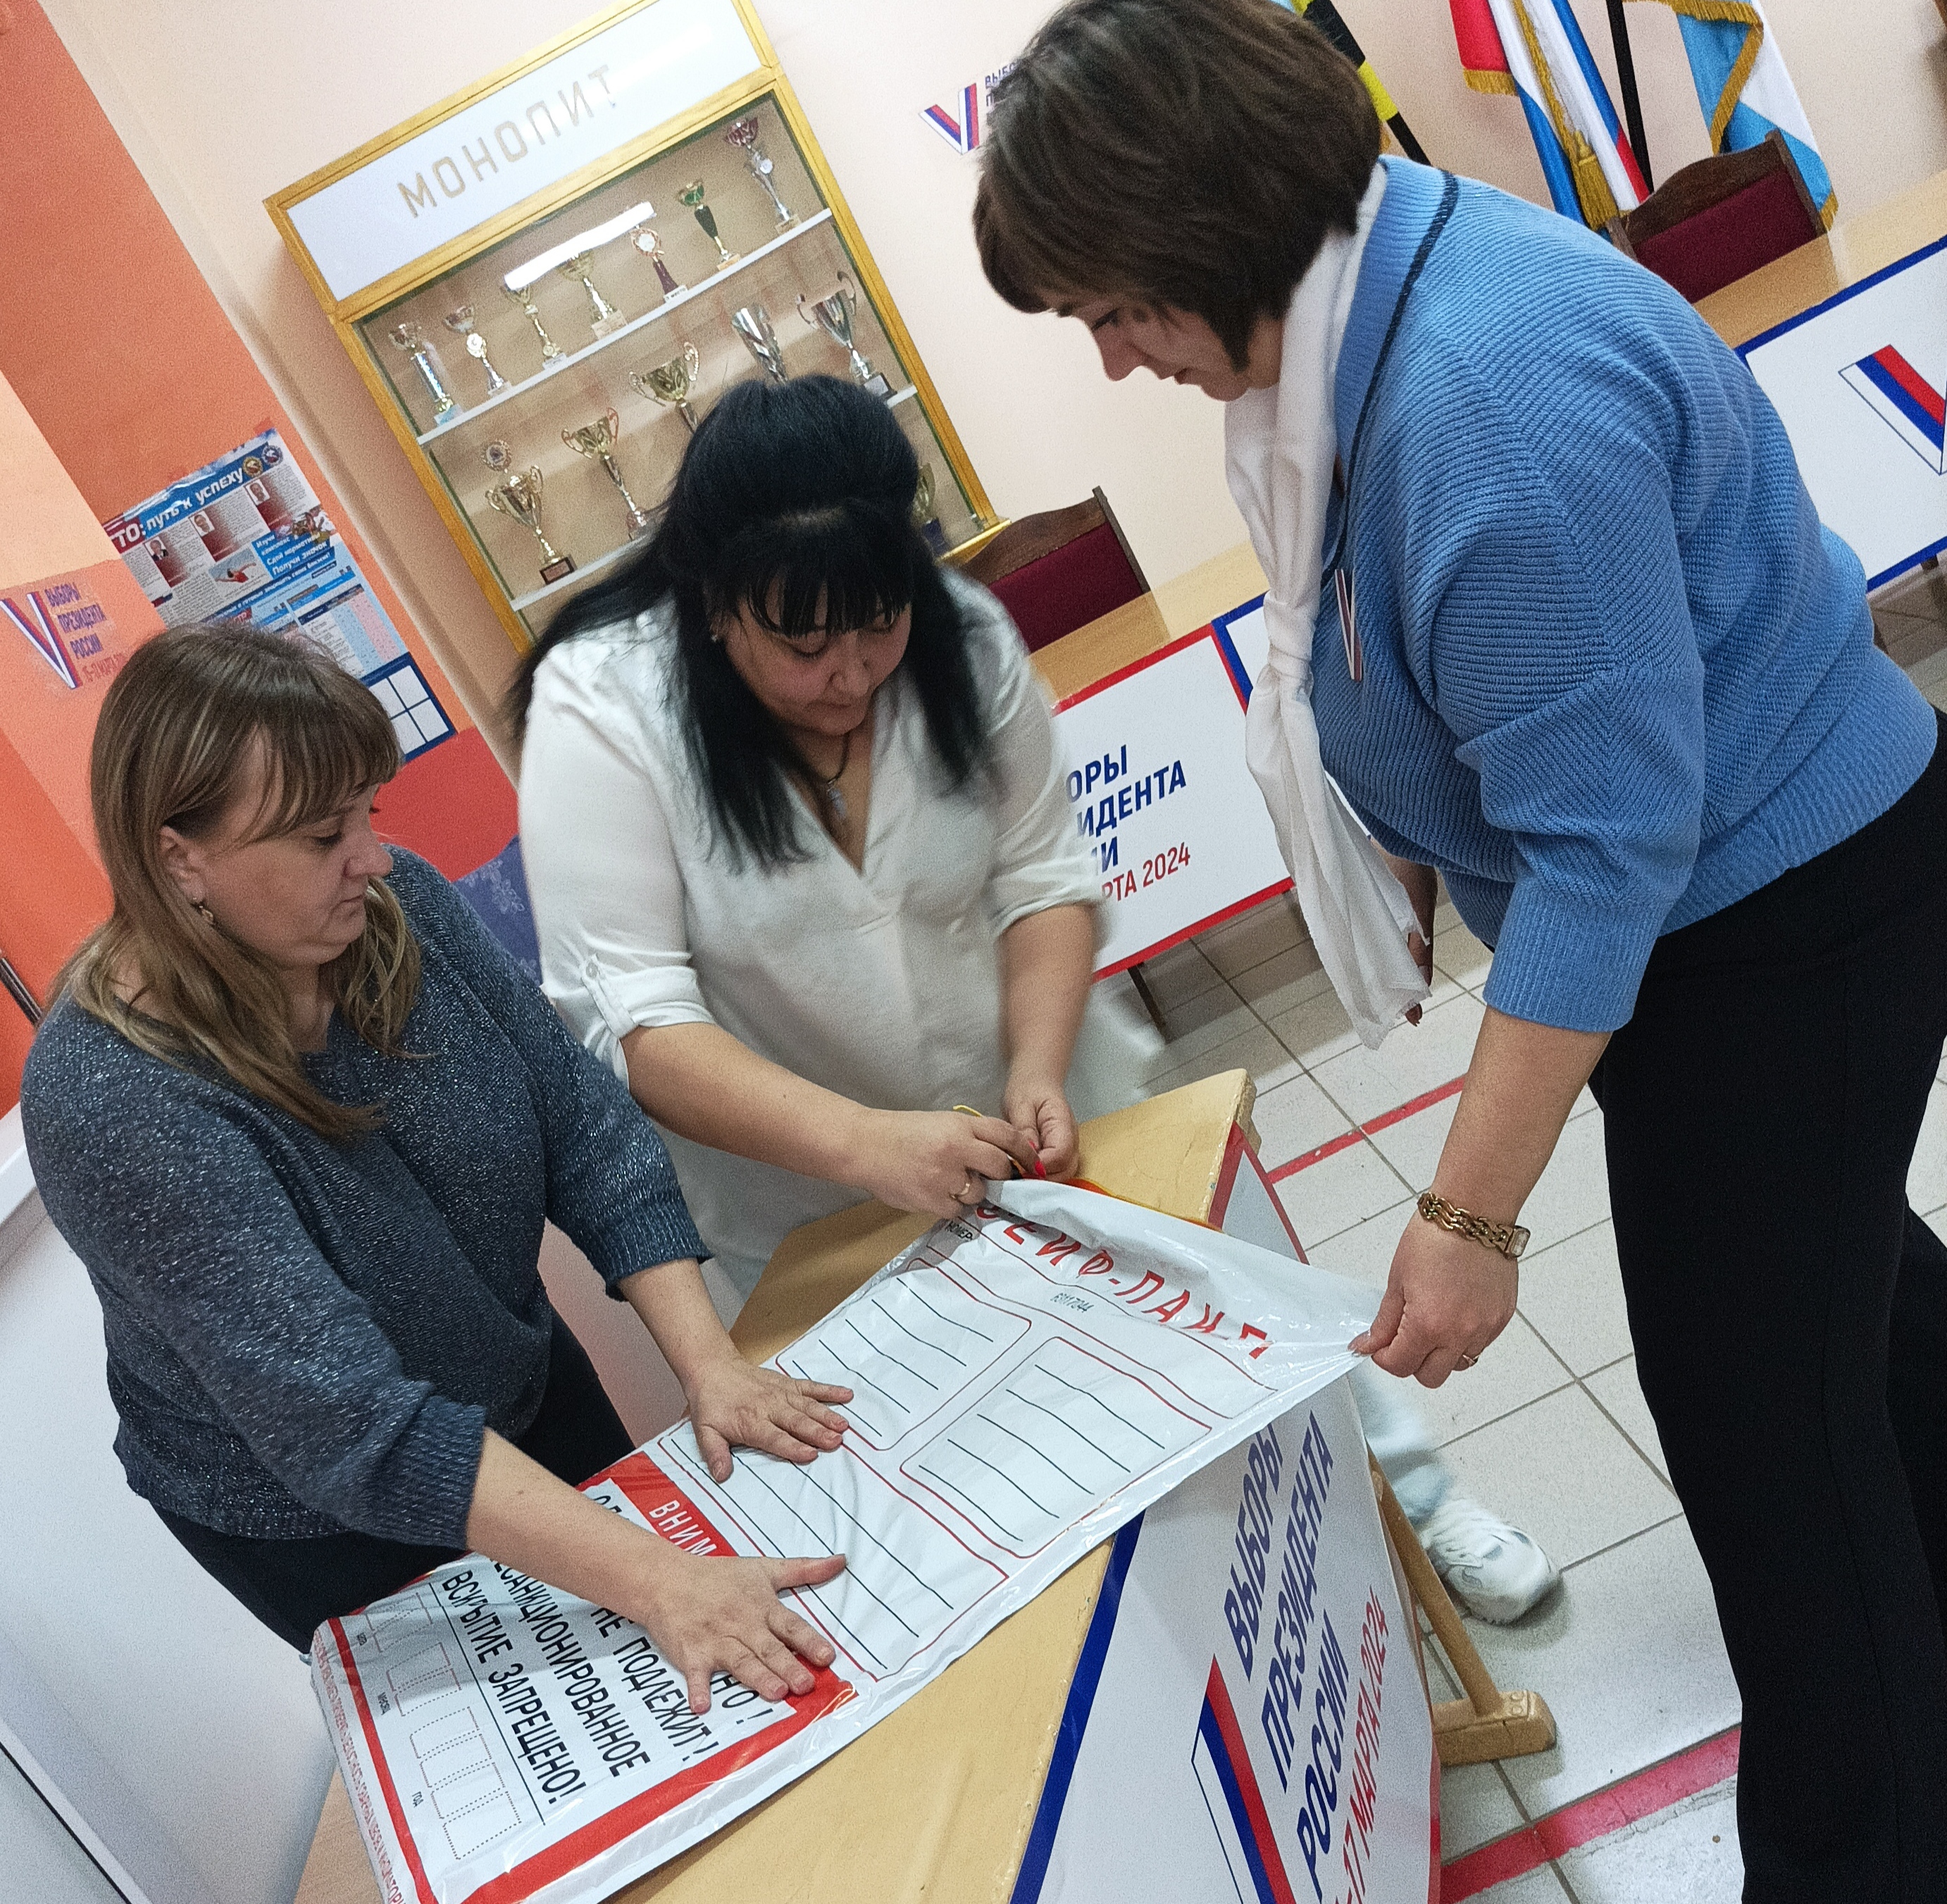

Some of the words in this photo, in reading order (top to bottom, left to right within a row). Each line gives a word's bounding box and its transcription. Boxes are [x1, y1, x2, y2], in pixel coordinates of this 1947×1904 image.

[111, 516, 147, 549] ТО:
[147, 505, 180, 533] путь
[183, 497, 192, 510] к
[195, 468, 243, 505] успеху
[44, 582, 82, 607] ВЫБОРЫ
[272, 556, 301, 575] Получи
[301, 541, 328, 560] значок
[57, 604, 107, 634] ПРЕЗИДЕНТА
[70, 633, 104, 659] РОССИИ
[1066, 745, 1127, 803] ОРЫ
[1076, 760, 1186, 838] ИДЕНТА
[1102, 870, 1138, 902] РТА
[1143, 842, 1190, 888] 2024
[649, 1500, 717, 1557] ВНИМ
[1224, 1421, 1283, 1684] ВЫБОРЫ
[1262, 1410, 1333, 1793] ПРЕЗИДЕНТА
[1360, 1584, 1388, 1712] 2024
[488, 1662, 587, 1805] ЗАПРЕЩЕНО!
[1297, 1608, 1349, 1904] РОССИИ
[1350, 1676, 1381, 1861] МАРТА
